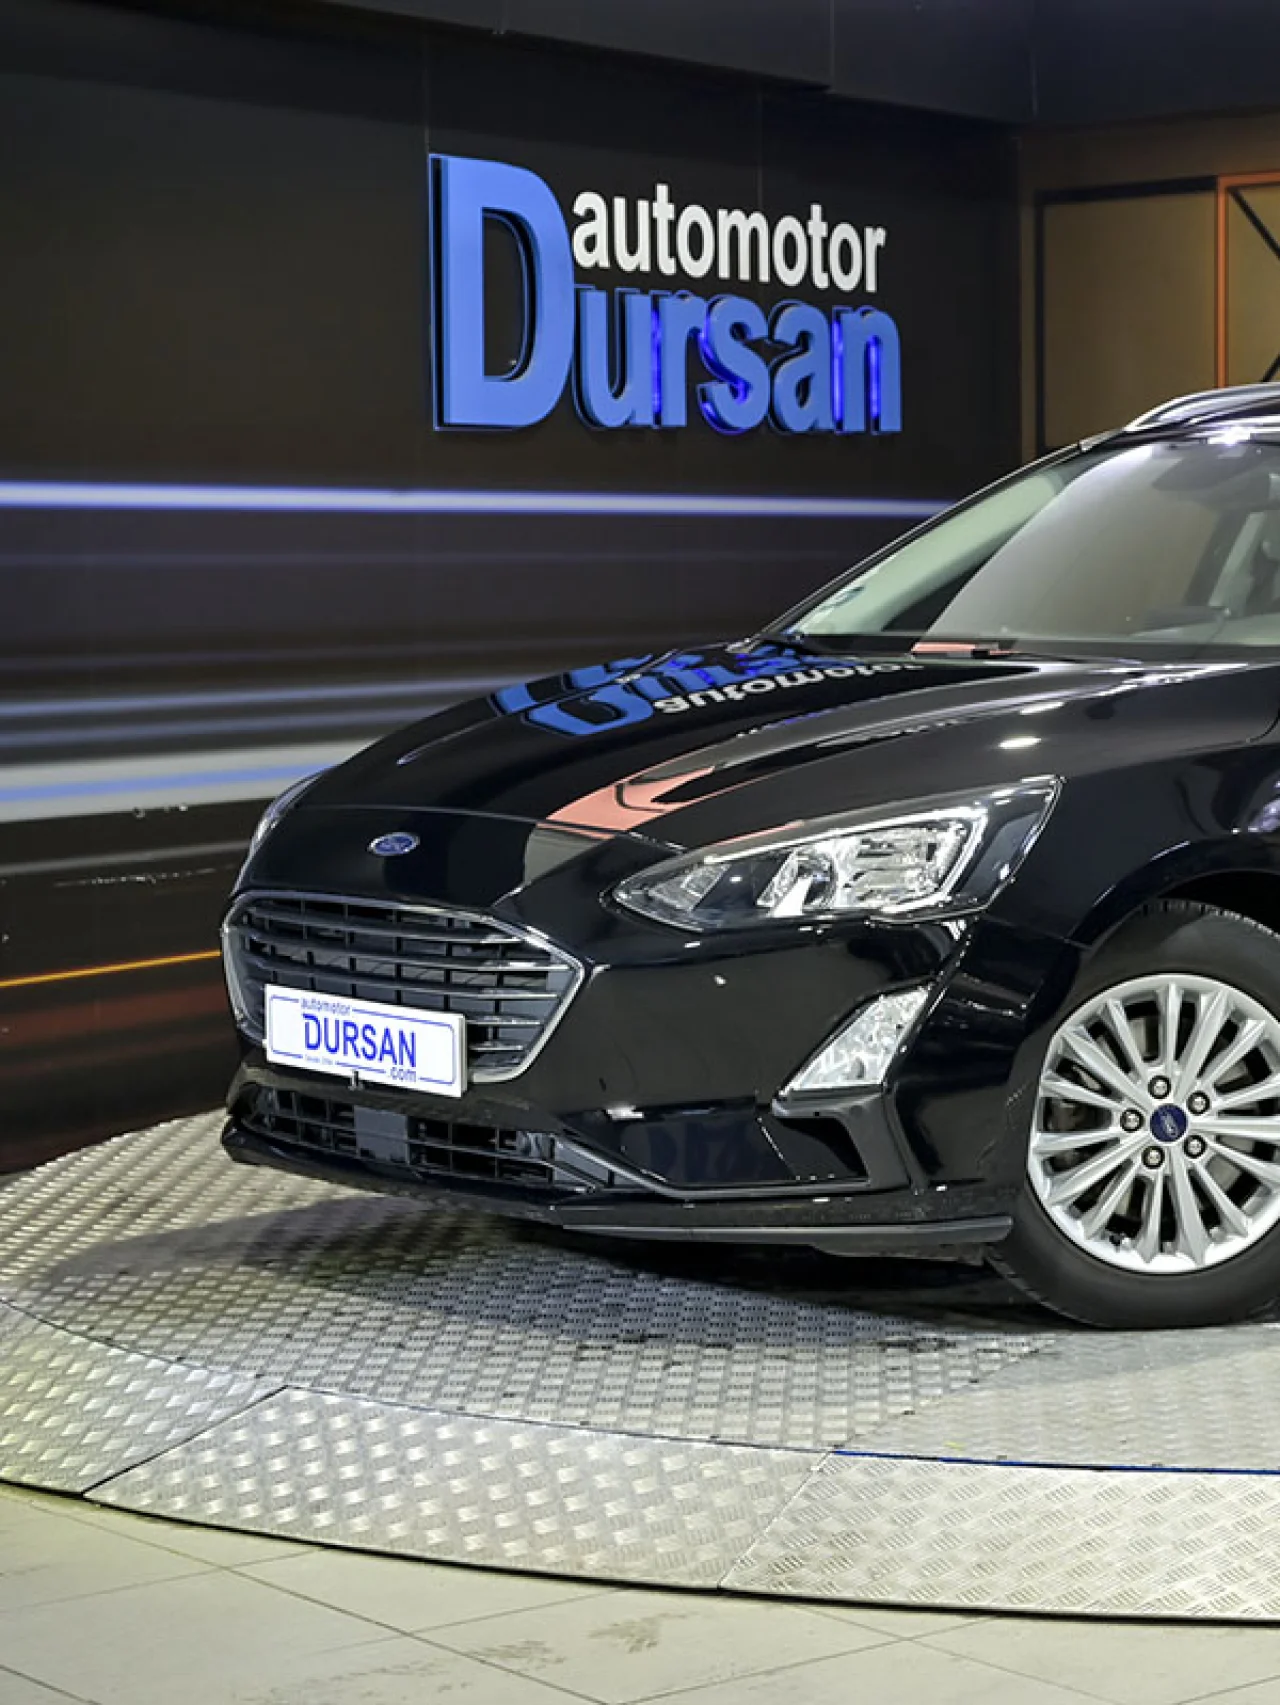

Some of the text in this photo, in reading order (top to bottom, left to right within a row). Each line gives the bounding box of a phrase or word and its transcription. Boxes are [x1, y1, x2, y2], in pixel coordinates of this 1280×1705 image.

[572, 183, 887, 293] automotor
[429, 153, 902, 434] Dursan
[300, 998, 351, 1016] automotor
[302, 1013, 417, 1068] DURSAN
[387, 1066, 417, 1083] .com
